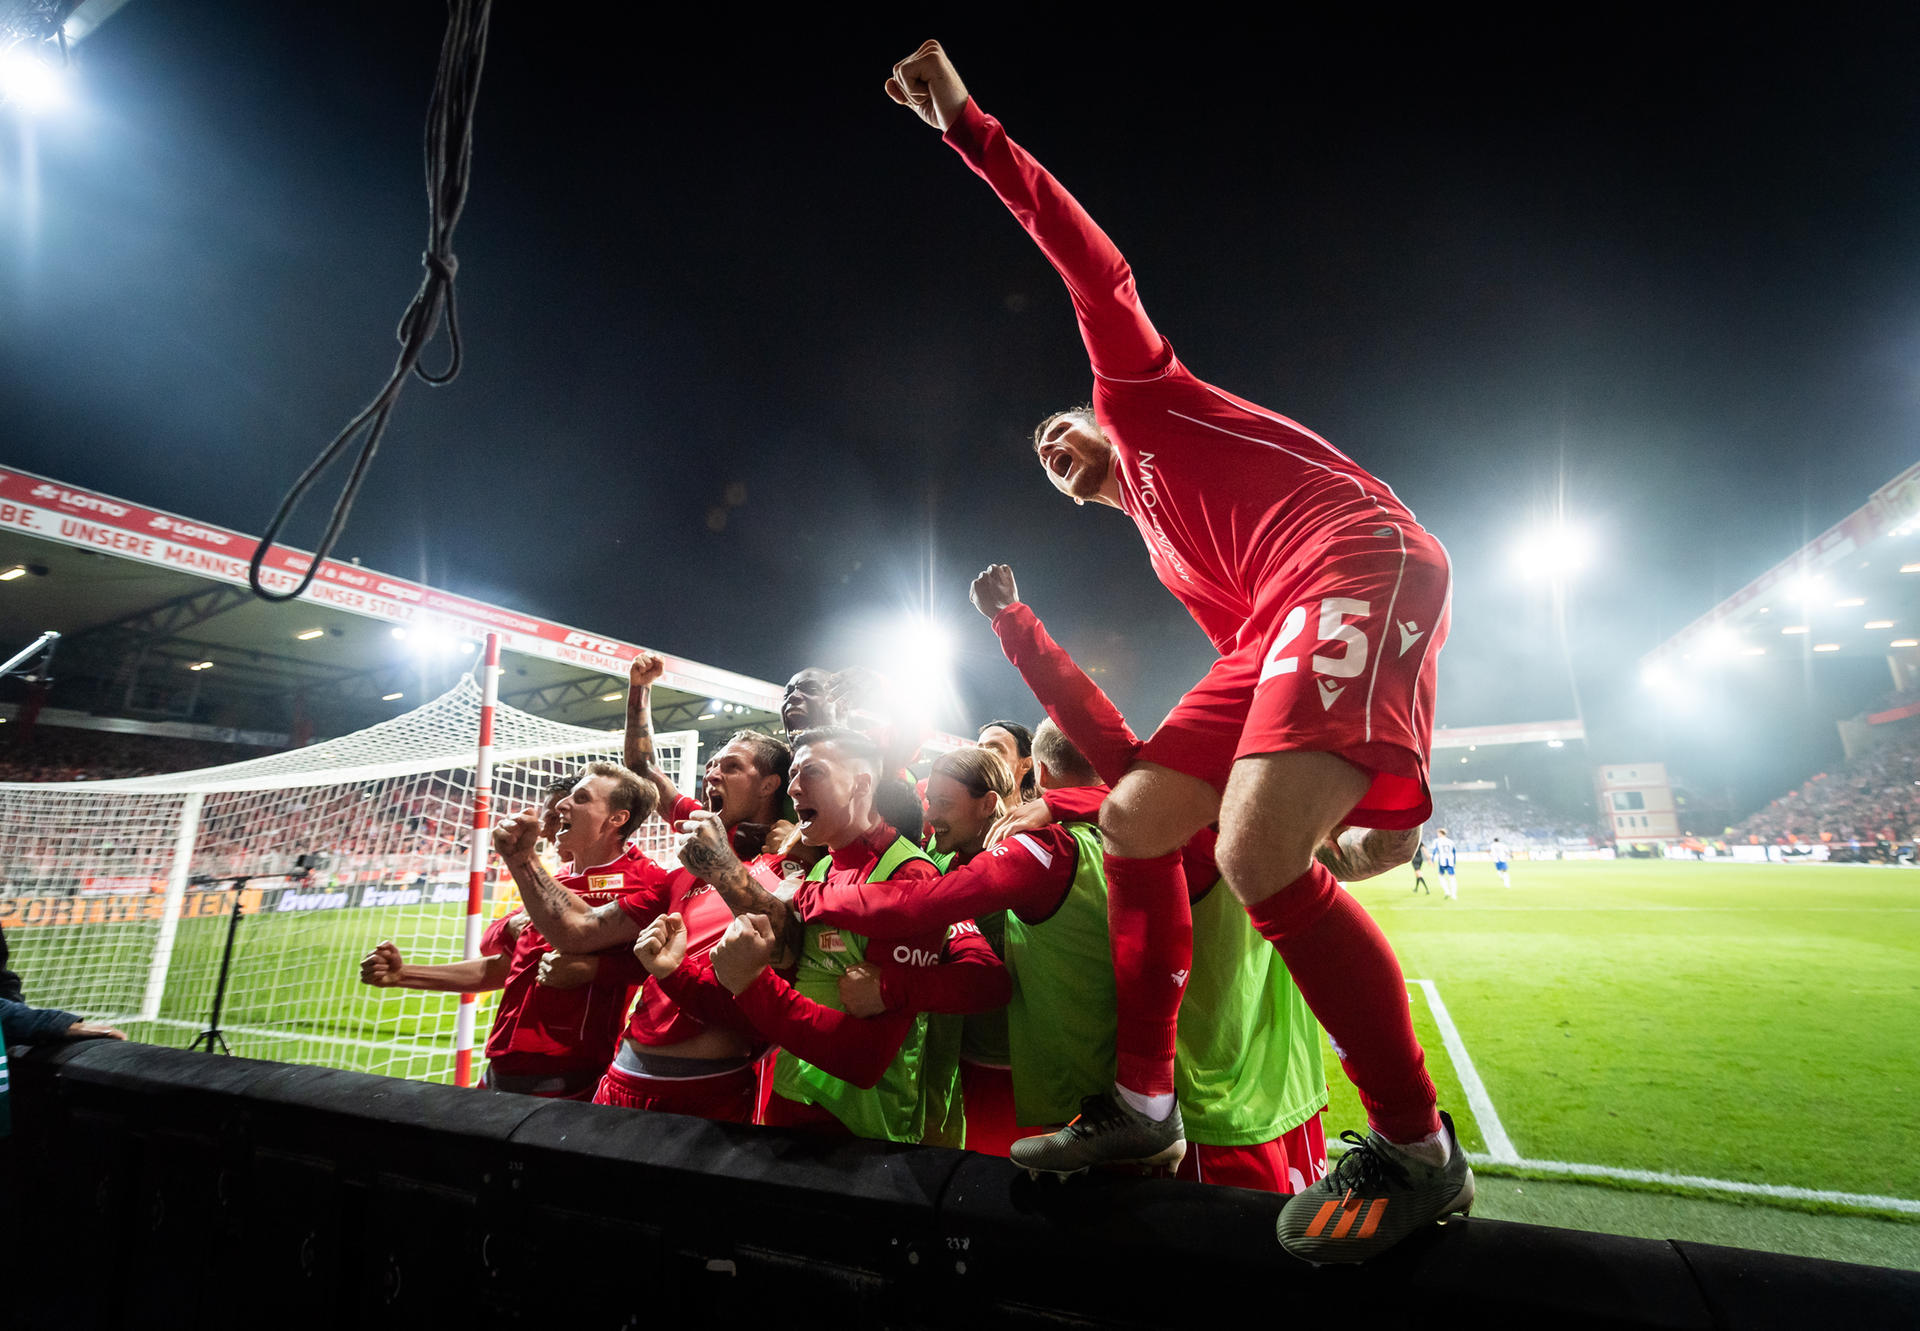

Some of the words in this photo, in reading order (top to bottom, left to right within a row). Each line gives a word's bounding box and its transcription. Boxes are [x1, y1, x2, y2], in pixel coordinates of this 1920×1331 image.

[60, 491, 131, 518] LOTTO
[171, 522, 233, 546] LOTTO
[61, 519, 153, 557] UNSERE
[311, 583, 365, 609] UNSER
[563, 631, 619, 656] RTC
[1258, 597, 1371, 686] 25
[277, 889, 349, 913] bwin
